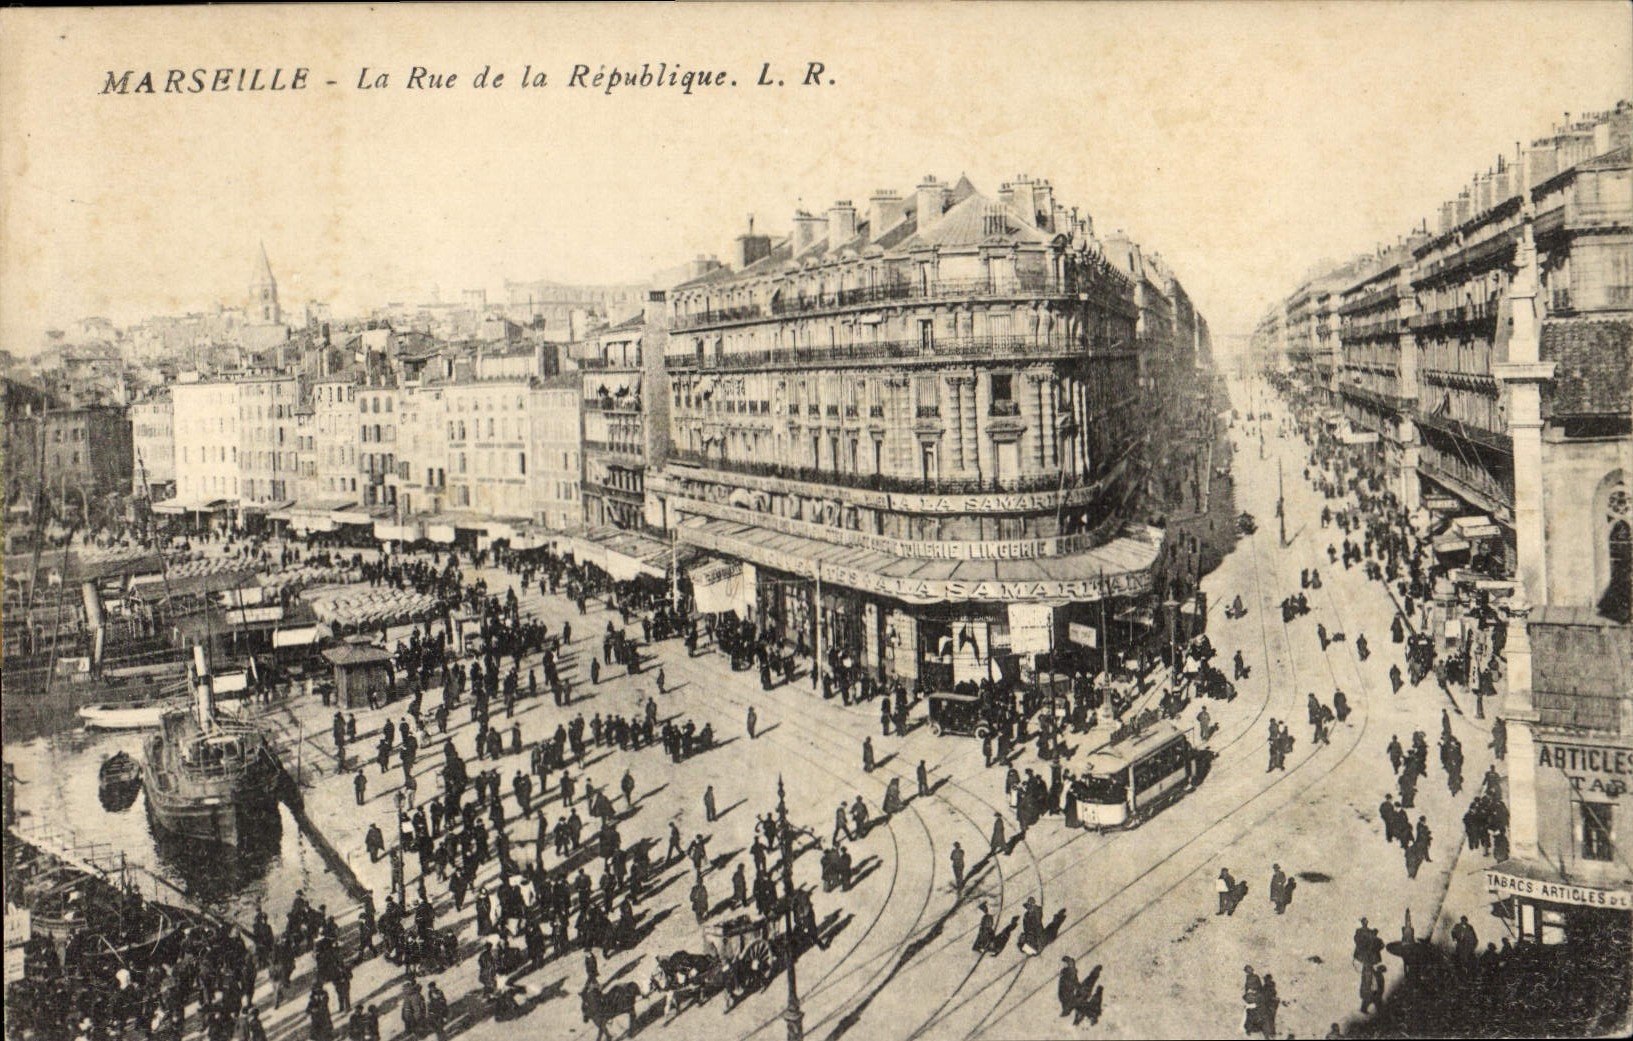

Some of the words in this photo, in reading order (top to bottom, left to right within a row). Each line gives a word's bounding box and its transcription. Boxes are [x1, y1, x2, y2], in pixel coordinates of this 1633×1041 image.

[919, 497, 955, 513] LA
[968, 540, 1047, 560] LINGERIE
[896, 579, 939, 599] LA
[1487, 873, 1533, 894] TABACS
[1541, 885, 1606, 905] ARTICLES
